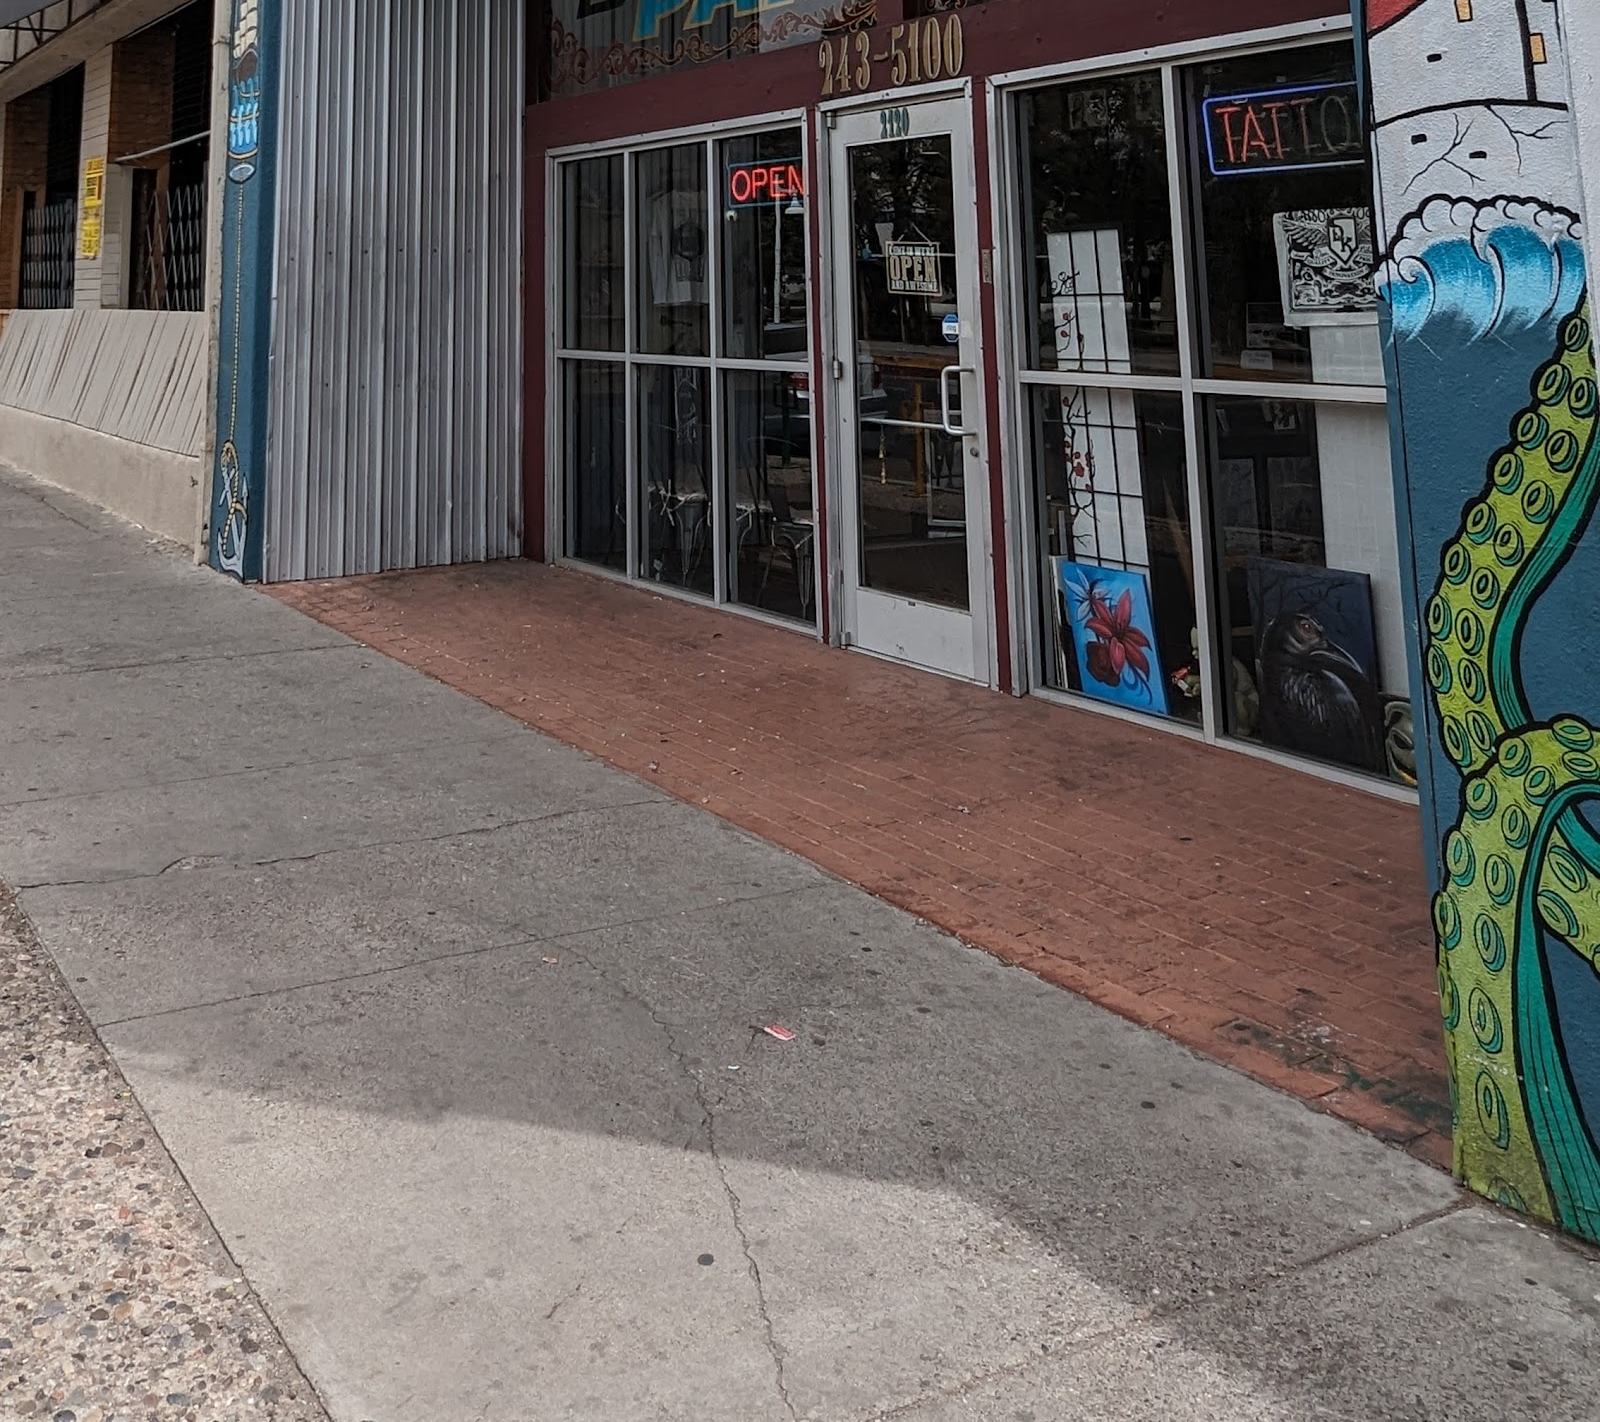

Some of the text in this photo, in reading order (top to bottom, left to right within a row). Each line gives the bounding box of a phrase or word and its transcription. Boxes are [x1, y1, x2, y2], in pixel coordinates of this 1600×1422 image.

[818, 12, 964, 95] 243-5100
[879, 107, 910, 139] 2120
[732, 165, 804, 201] OPEN
[889, 256, 937, 282] OPEN
[891, 280, 938, 292] AND AWESOME
